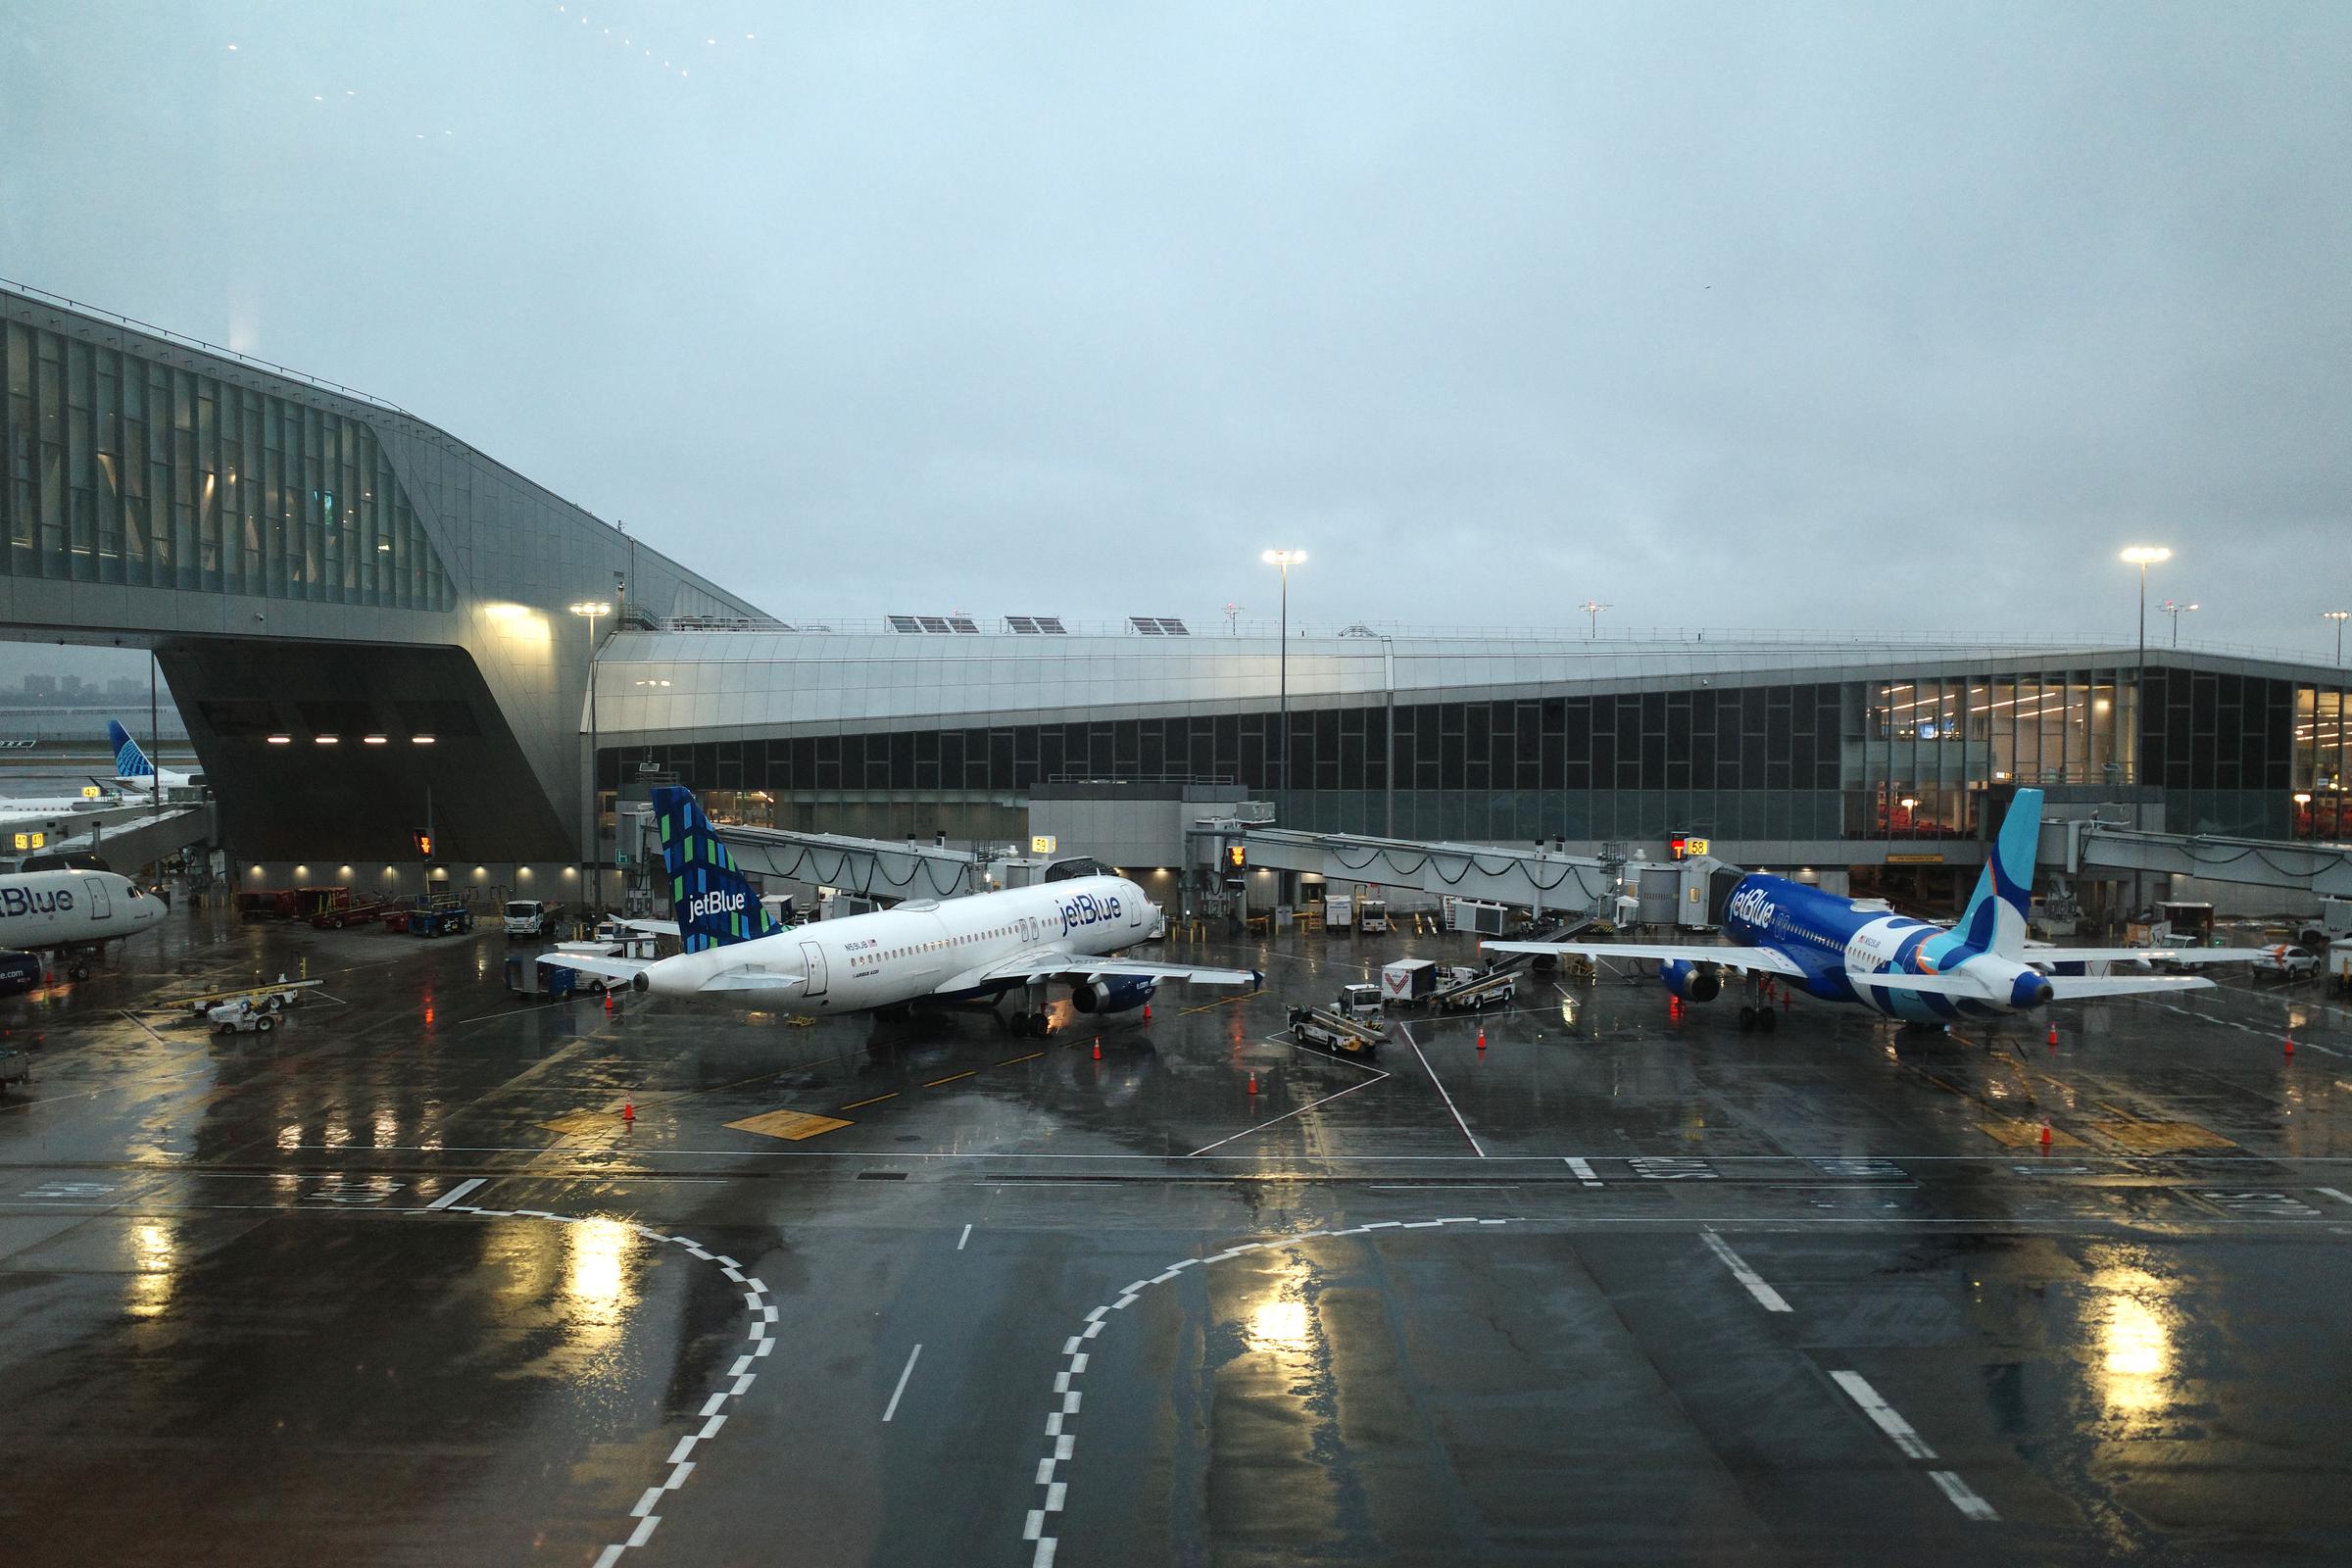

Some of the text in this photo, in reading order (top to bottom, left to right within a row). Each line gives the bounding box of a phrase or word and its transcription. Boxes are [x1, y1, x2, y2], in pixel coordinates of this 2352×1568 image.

[1691, 841, 1704, 854] 58
[0, 886, 74, 917] Blue
[688, 890, 745, 923] jetBlue
[1054, 893, 1122, 938] jetBlue
[1730, 884, 1775, 928] jetBlue
